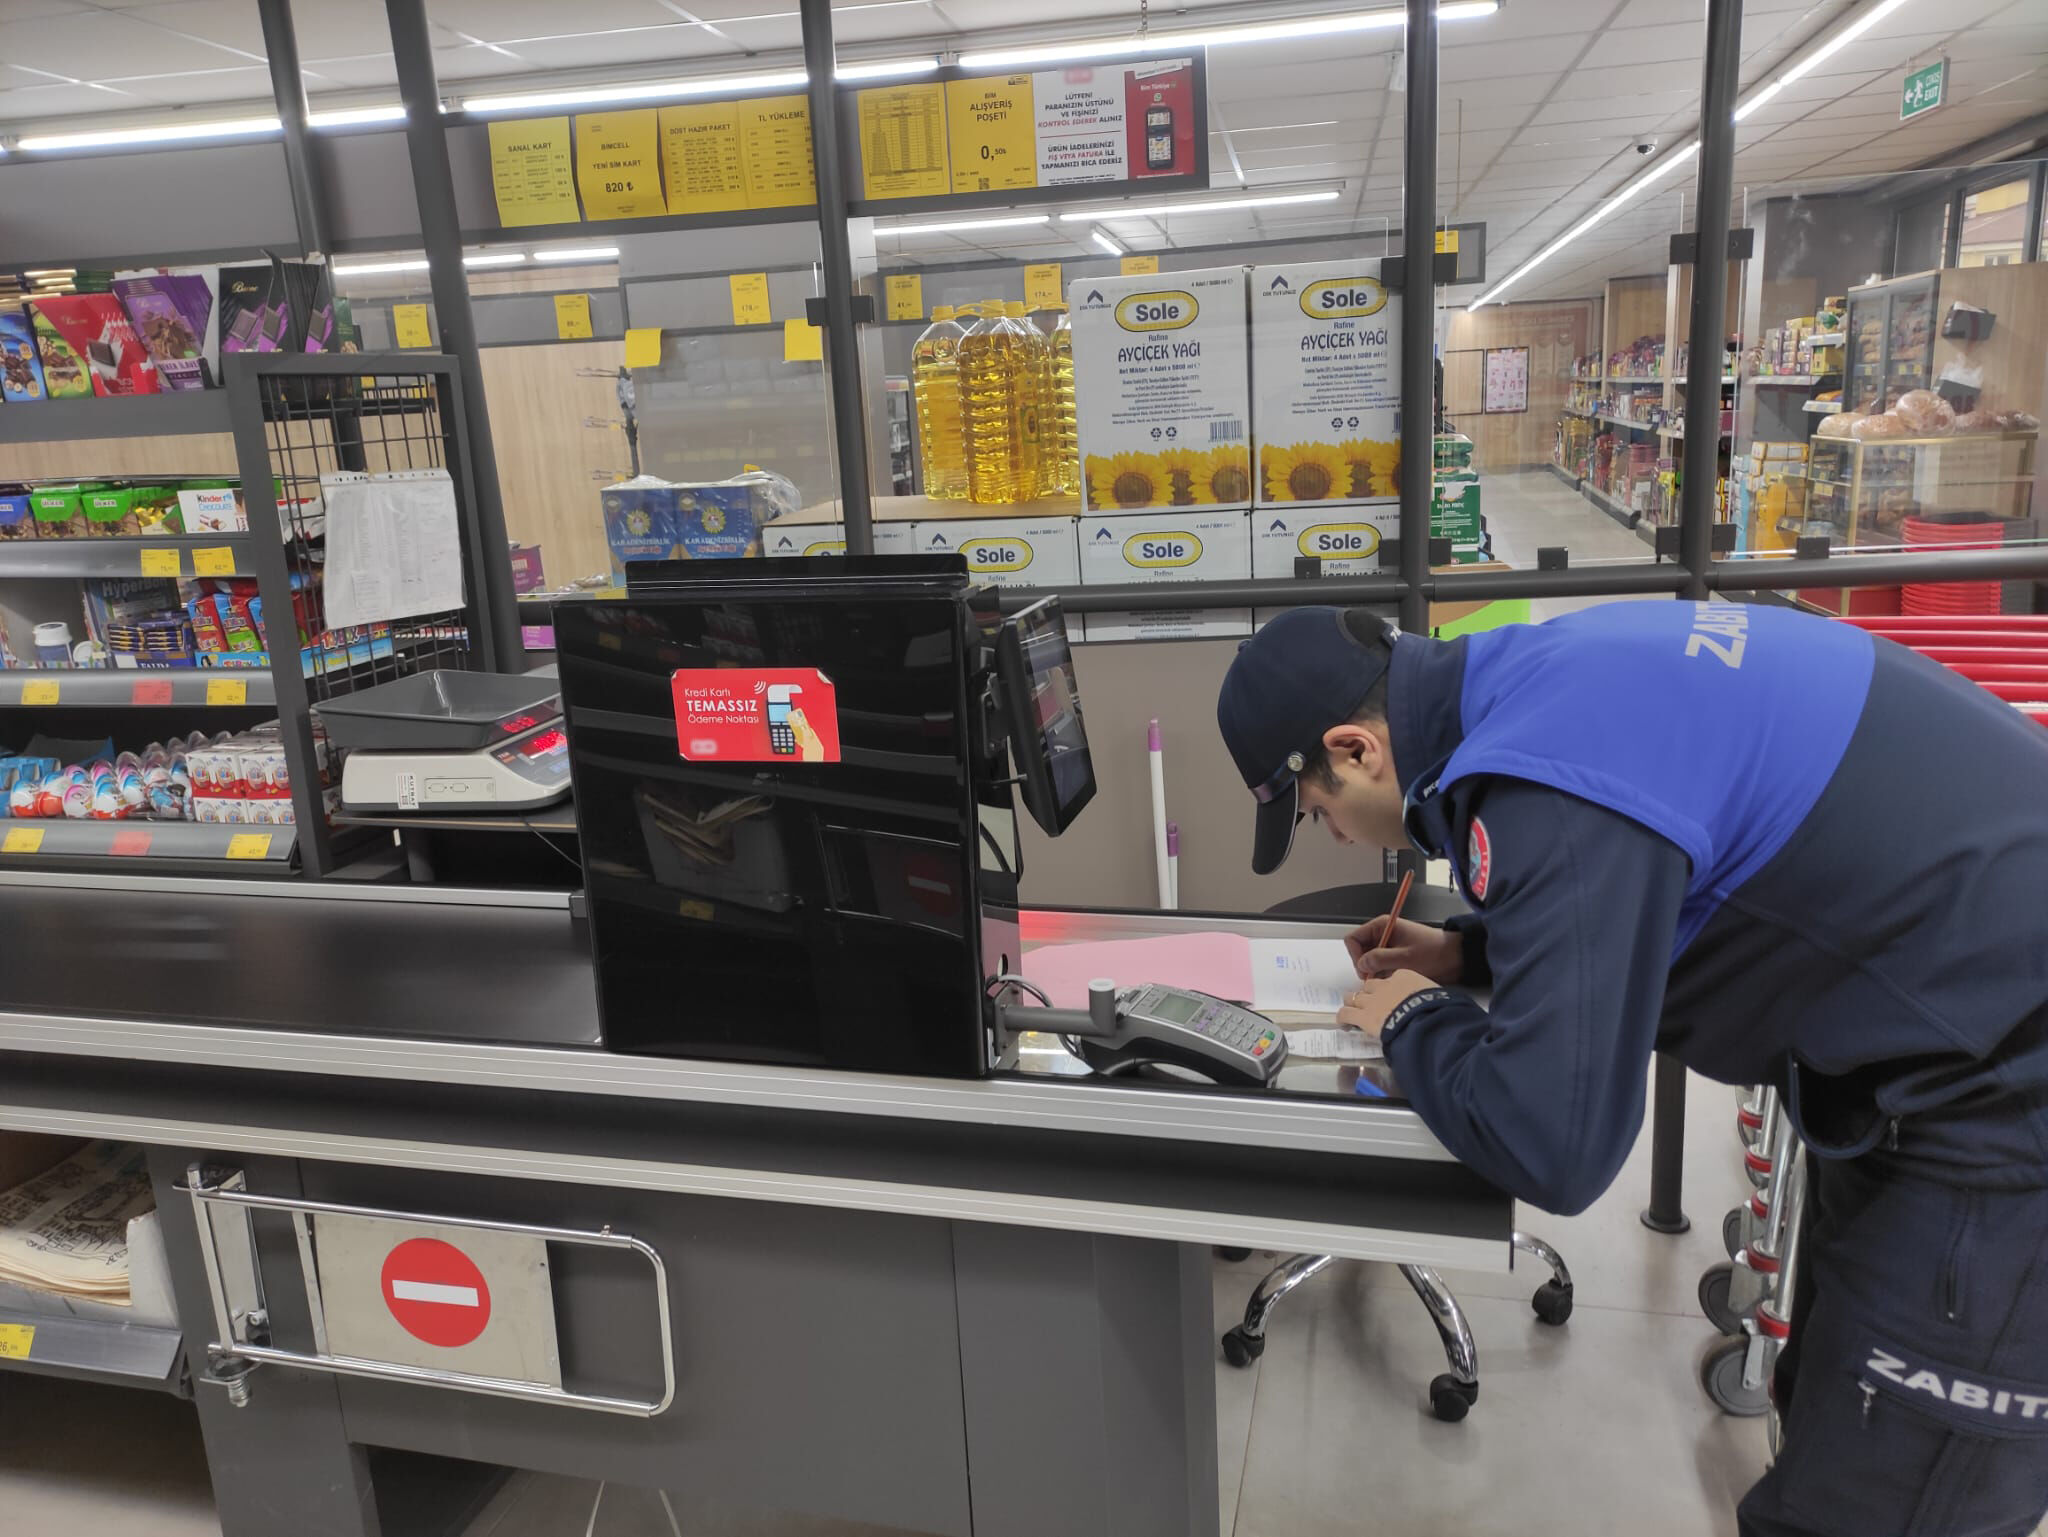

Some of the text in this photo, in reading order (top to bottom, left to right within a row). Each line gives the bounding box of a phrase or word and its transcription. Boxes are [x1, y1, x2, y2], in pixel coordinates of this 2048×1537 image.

[1924, 86, 1939, 101] EXIT
[969, 100, 1013, 112] ALIŞVERİŞ
[769, 110, 806, 121] YÜKLEME
[1099, 114, 1123, 123] ALINIZ
[688, 126, 708, 134] HAZIR
[508, 142, 552, 152] SANAL KART
[592, 162, 608, 170] YENİ
[610, 160, 621, 168] SİM
[605, 182, 624, 193] 820
[1321, 289, 1368, 308] Sole
[1136, 302, 1180, 322] Sole
[1301, 328, 1388, 352] AYÇİÇEK YAĞI
[1118, 340, 1200, 363] AYÇİÇEK YAĞI
[1318, 534, 1362, 550] Sole
[976, 546, 1016, 564] Sole
[1142, 542, 1184, 559] Sole
[1329, 562, 1350, 570] Rafine
[1154, 570, 1174, 578] Rafine
[684, 688, 731, 697] Kredi Kartı
[686, 700, 758, 712] TEMASSIZ
[688, 714, 759, 724] Ödeme Noktası
